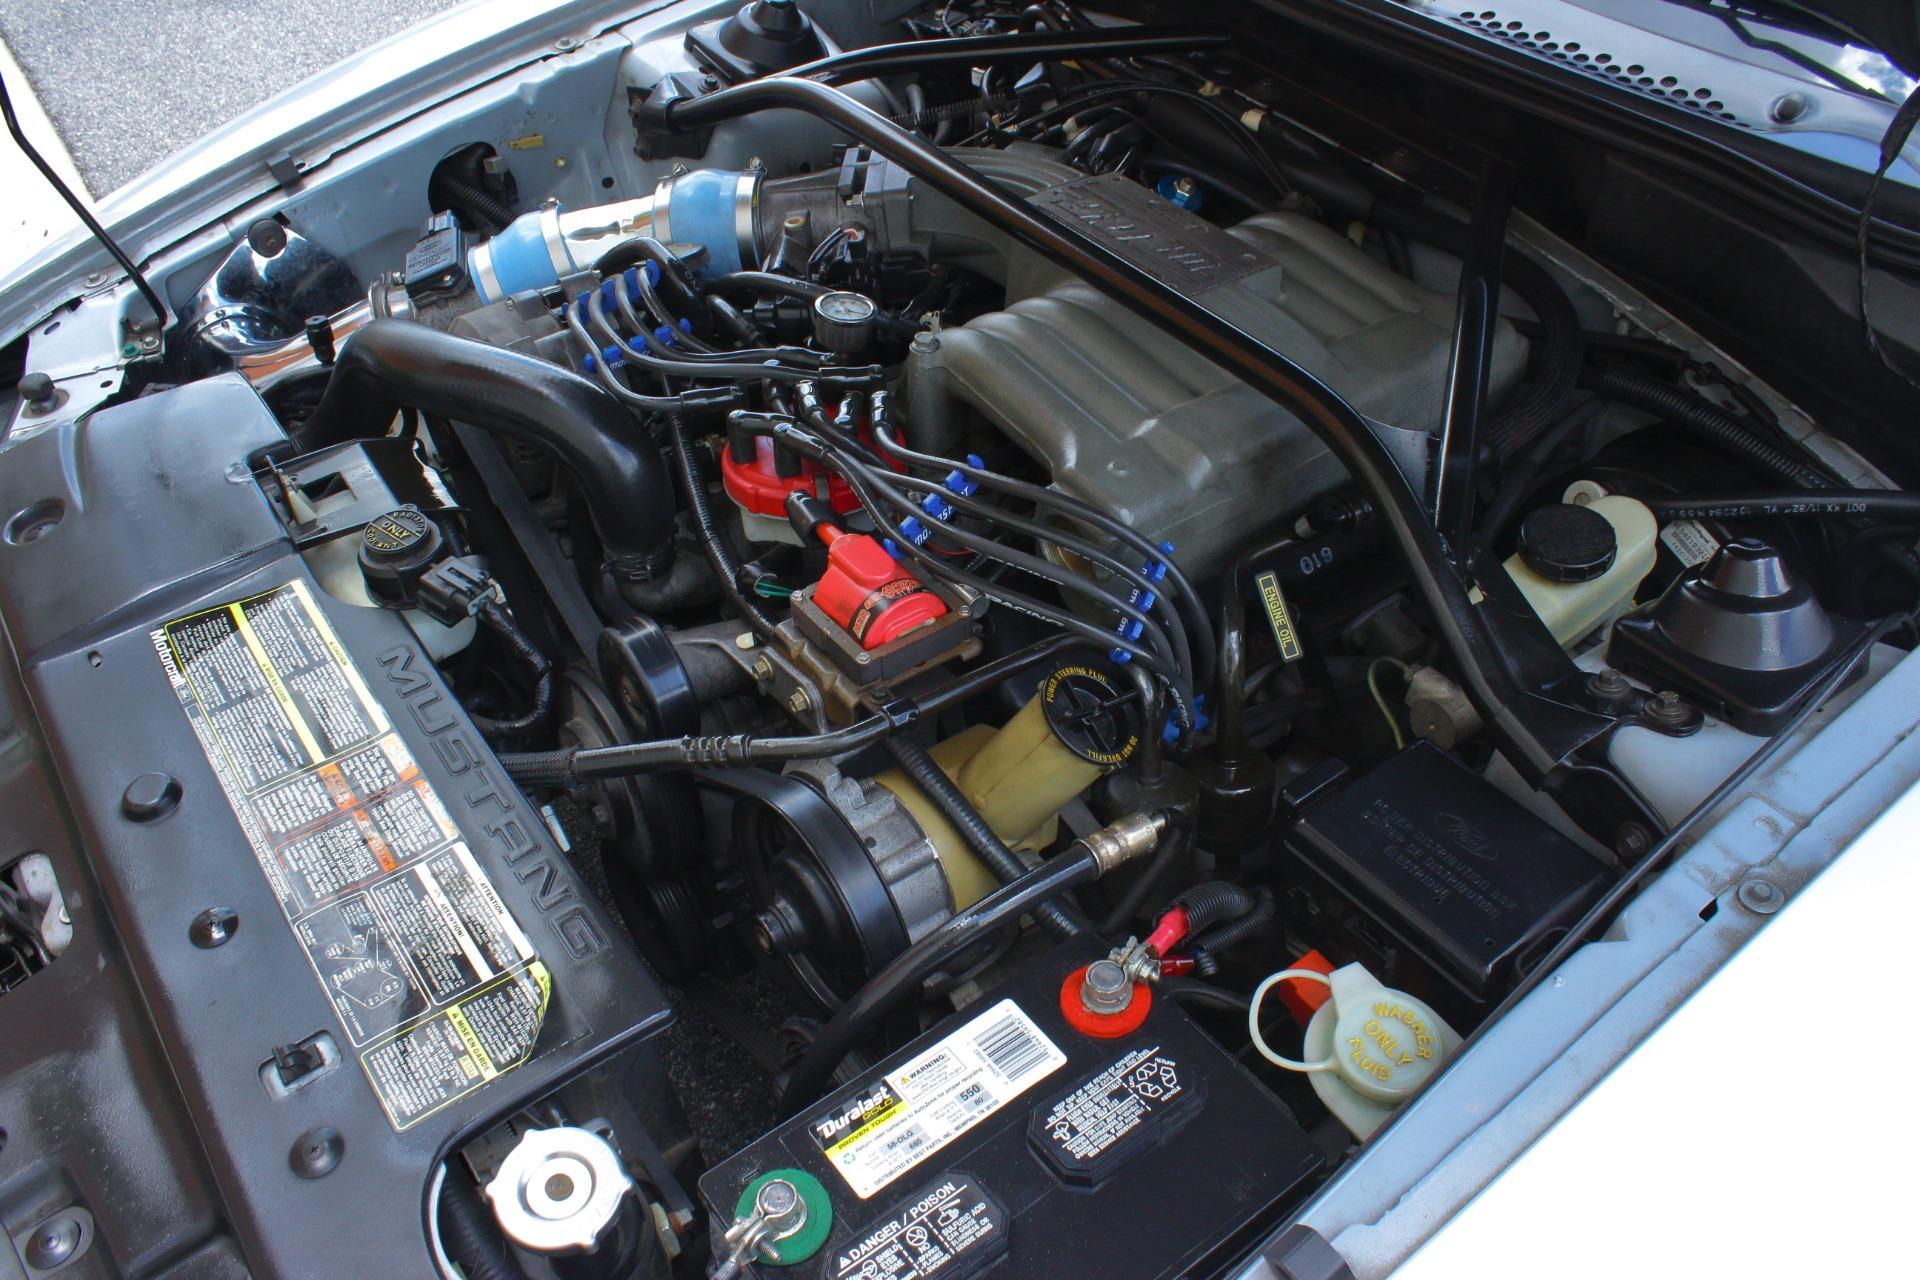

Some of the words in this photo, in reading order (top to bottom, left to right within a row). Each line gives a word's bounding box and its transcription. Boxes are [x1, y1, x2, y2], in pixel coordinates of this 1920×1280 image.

[394, 511, 425, 534] RADIATOR
[1846, 503, 1866, 512] DOT
[367, 528, 399, 549] COOLANT
[382, 520, 411, 539] ONLY
[1264, 585, 1287, 627] ENGINE
[1279, 628, 1292, 649] OIL
[150, 629, 186, 687] Motorcraft
[1046, 678, 1058, 703] POWER
[1054, 666, 1087, 680] STEERING
[1086, 748, 1122, 763] OVERFILL
[1120, 745, 1134, 758] NOT
[1129, 735, 1138, 746] DO
[376, 646, 612, 961] MUSTANG
[344, 819, 353, 828] NE
[350, 829, 359, 839] PAS
[356, 840, 378, 871] MANIPULER
[480, 881, 503, 915] ATTENTION
[456, 1019, 470, 1037] MISE
[466, 1037, 476, 1047] EN
[472, 1048, 490, 1072] GARDE
[1363, 1019, 1415, 1067] ONLY
[1373, 1001, 1433, 1061] WASHER
[909, 1052, 947, 1079] WARNING:
[1349, 1036, 1392, 1082] FLUID
[913, 1096, 937, 1114] AutoZone
[944, 1081, 961, 1093] proper
[961, 1066, 983, 1083] recycling
[959, 1084, 981, 1101] 550
[1047, 1114, 1057, 1123] DO
[1055, 1108, 1066, 1116] NOT
[1075, 1092, 1088, 1103] KEEP
[1087, 1084, 1100, 1094] VENT
[1099, 1075, 1113, 1085] CAPS
[1112, 1065, 1126, 1076] TIGHT
[1126, 1058, 1136, 1066] AND
[1135, 1048, 1150, 1059] LEVEL
[1052, 1101, 1066, 1111] KEEP
[1065, 1094, 1076, 1103] OUT
[1075, 1088, 1084, 1096] OF
[1083, 1081, 1093, 1090] THE
[1092, 1071, 1108, 1083] REACH
[1107, 1065, 1116, 1073] OF
[1114, 1050, 1137, 1068] CHILDREN
[816, 1085, 891, 1139] Duralast
[861, 1097, 894, 1120] GOLD
[973, 1096, 984, 1105] 80
[1065, 1108, 1082, 1121] FLUSH
[1080, 1099, 1094, 1110] EYES
[1091, 1080, 1121, 1102] IMMEDIATELY
[1071, 1115, 1084, 1126] WITH
[1098, 1096, 1110, 1106] GET
[1076, 1115, 1097, 1131] MEDICAL
[1094, 1106, 1108, 1118] HELP
[1106, 1098, 1119, 1109] FAST
[837, 1126, 869, 1149] PROVEN
[870, 1109, 896, 1127] TOUGH
[1072, 1139, 1090, 1153] FOLLOW
[1122, 1103, 1139, 1116] VEHICLE
[1085, 1128, 1095, 1137] FOR
[1115, 1098, 1137, 1114] STARTING
[873, 1162, 906, 1185] DISTRIBUTED
[912, 1148, 926, 1159] BEST
[977, 1107, 985, 1115] TN
[886, 1129, 914, 1150] 58-DLG
[908, 1138, 922, 1149] 685
[848, 1220, 901, 1259] DANGER
[898, 1212, 912, 1225] /
[908, 1181, 956, 1217] POISON
[941, 1212, 971, 1235] SULFURIC
[969, 1202, 986, 1215] ACID
[946, 1230, 959, 1241] CAN
[958, 1218, 976, 1232] CAUSE
[950, 1223, 980, 1246] BLINDNESS
[979, 1216, 989, 1226] OR
[917, 1241, 931, 1253] NO
[954, 1234, 976, 1251] SEVERE
[974, 1222, 993, 1237] BURNS
[874, 1244, 899, 1263] SHIELD
[874, 1258, 905, 1280] XPLOSIVE
[879, 1254, 898, 1269] EYES
